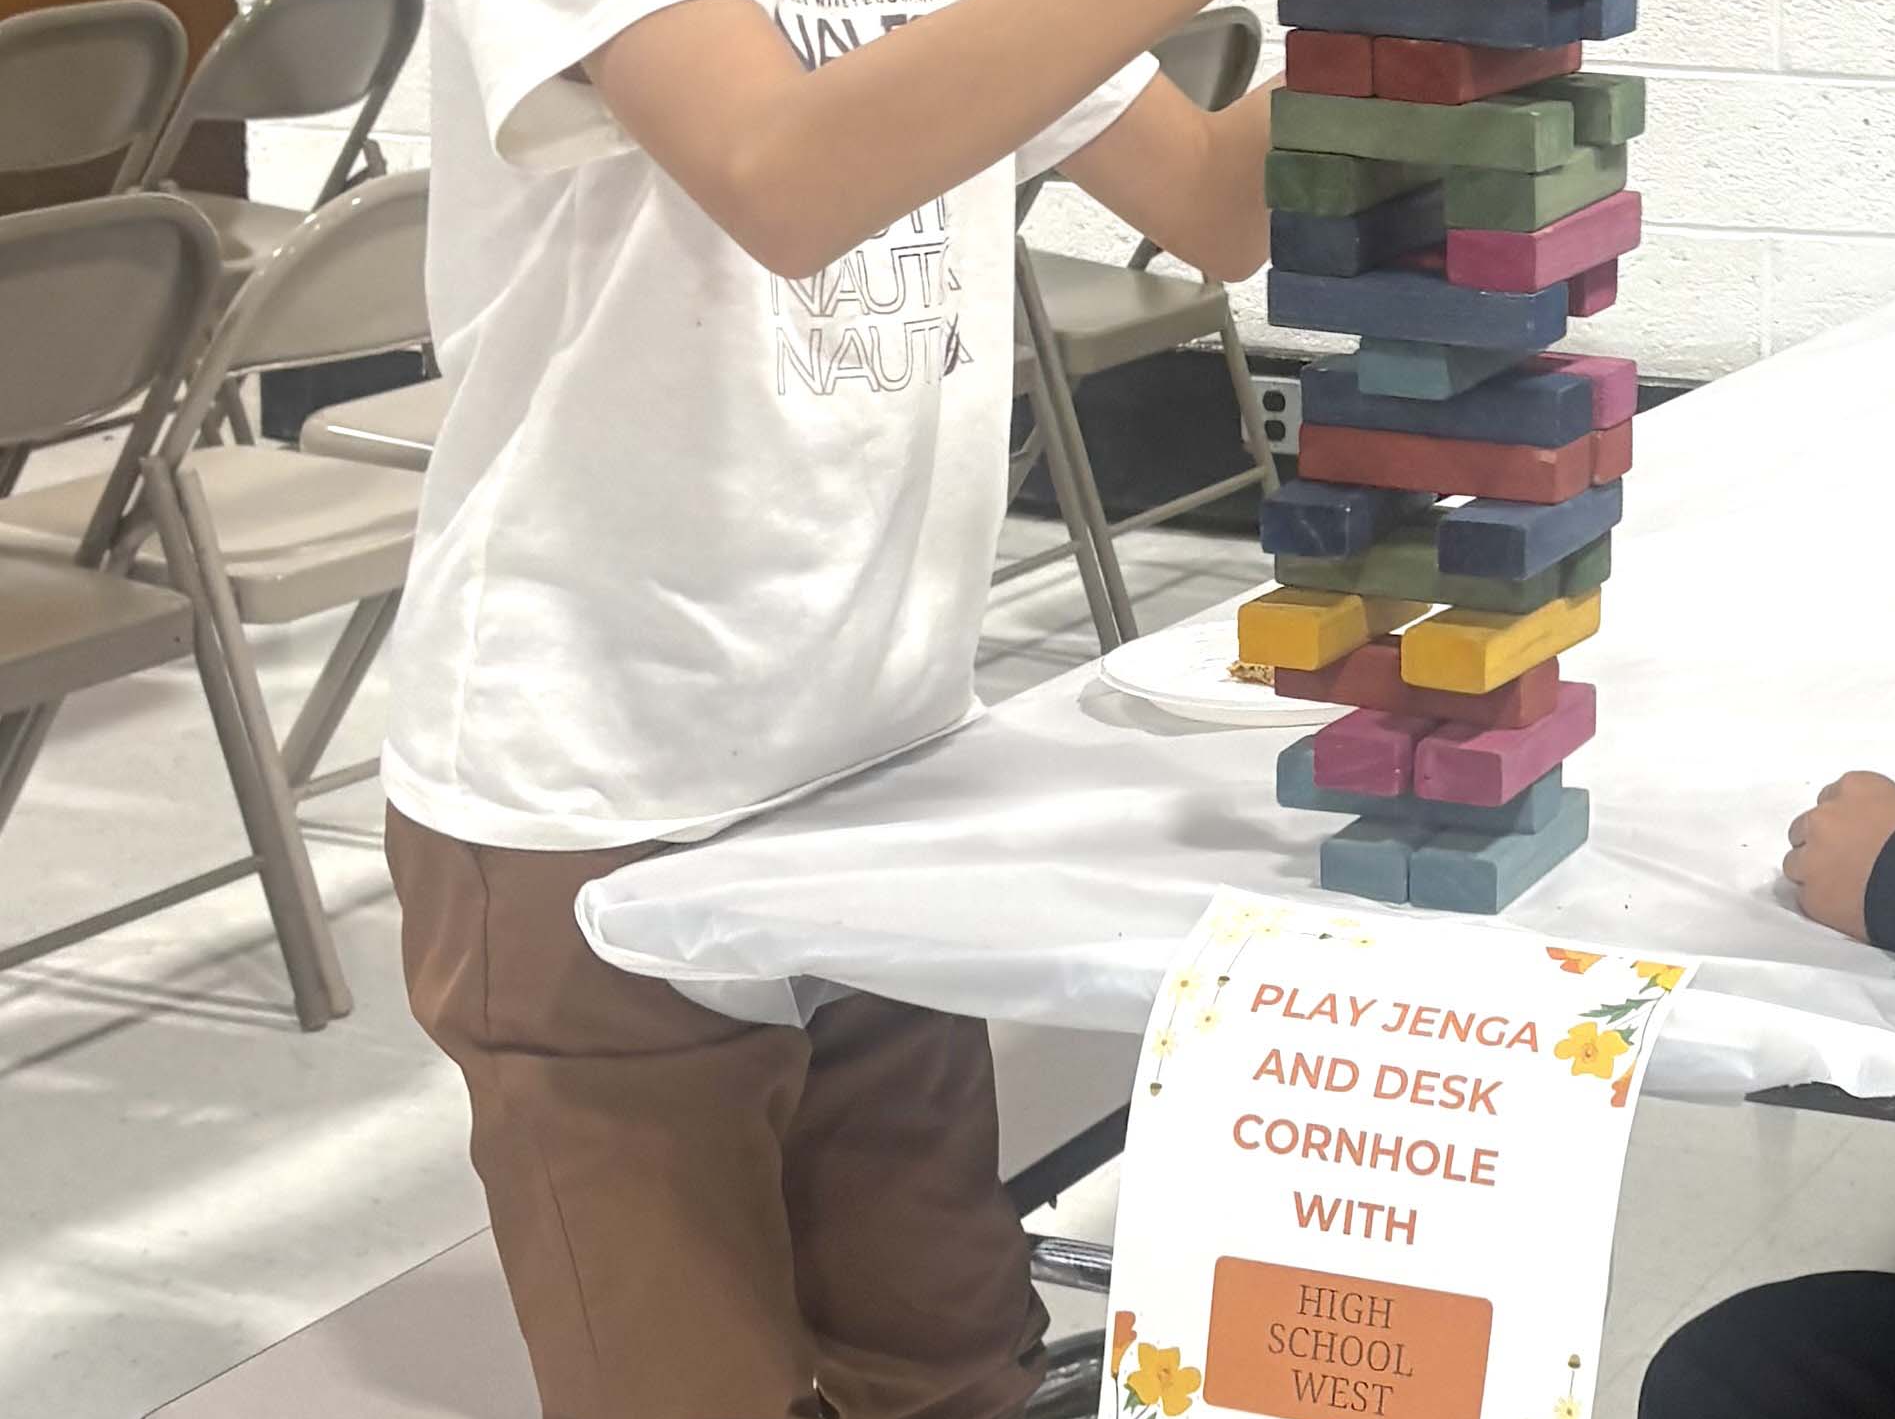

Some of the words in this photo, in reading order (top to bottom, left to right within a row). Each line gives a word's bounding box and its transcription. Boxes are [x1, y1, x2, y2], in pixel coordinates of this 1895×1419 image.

[1250, 982, 1378, 1027] PLAY
[1381, 1001, 1539, 1053] JENGA
[1252, 1047, 1360, 1093] AND
[1373, 1064, 1503, 1116] DESK
[1232, 1113, 1499, 1187] CORNHOLE
[1293, 1190, 1418, 1246] WITH
[1296, 1283, 1396, 1330] HIGH
[1267, 1322, 1414, 1378] SCHOOL
[1291, 1368, 1394, 1417] WEST
